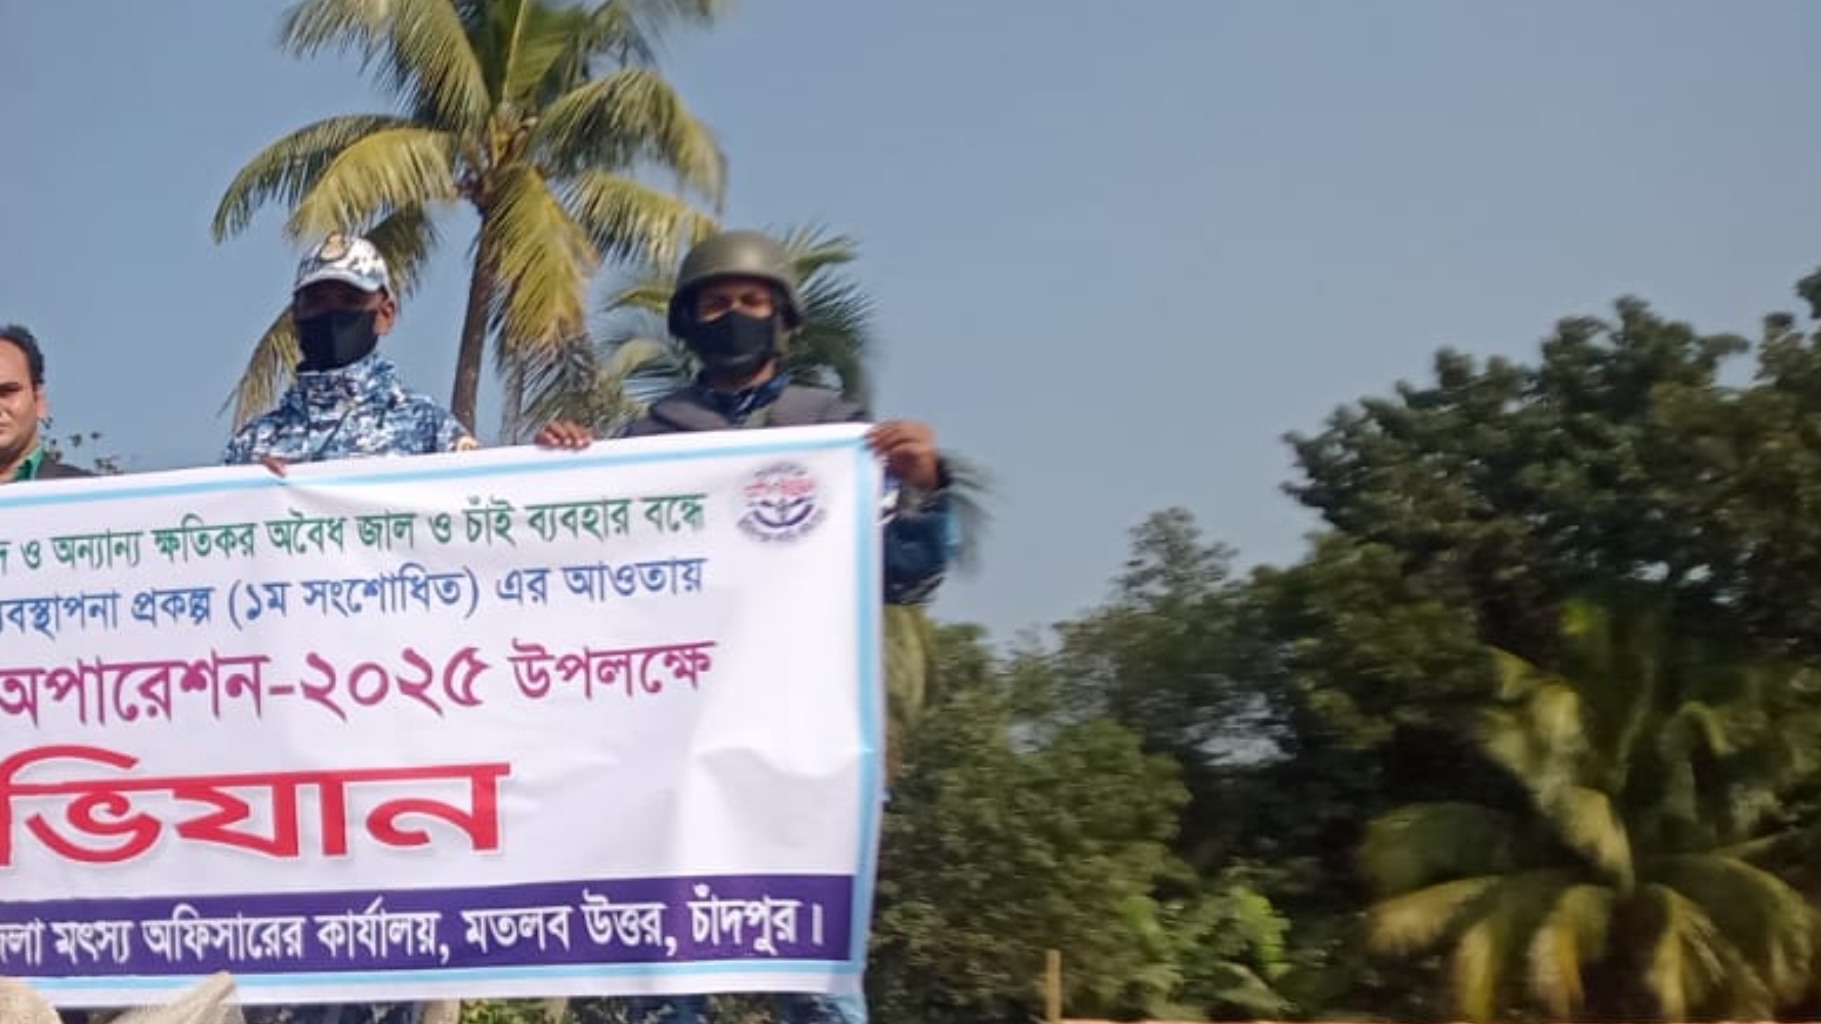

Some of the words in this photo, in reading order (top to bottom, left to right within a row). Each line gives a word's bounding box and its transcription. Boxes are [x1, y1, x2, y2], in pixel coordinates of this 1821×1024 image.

[20, 540, 41, 570] ও
[48, 528, 144, 570] অন্যান্য
[150, 513, 257, 561] ক্ষতিকর
[264, 507, 347, 555] অবৈধ
[354, 510, 417, 551] জাল
[429, 512, 452, 544] ও
[463, 496, 516, 546] চাঁই
[525, 496, 632, 541] ব্যবহার
[639, 493, 709, 533] বন্ধে
[132, 586, 216, 626] প্রকল্প
[229, 579, 292, 630] (১ম
[300, 562, 479, 619] সংশোধিত)
[496, 568, 551, 604] এর
[559, 557, 709, 602] আওতায়
[507, 638, 716, 699] উপলক্ষে
[50, 920, 134, 964] মৎস্য
[141, 903, 307, 962] অফিসারের
[314, 896, 450, 964] কার্যালয়,
[461, 906, 574, 953] মতলব
[579, 888, 677, 956] উত্তর,
